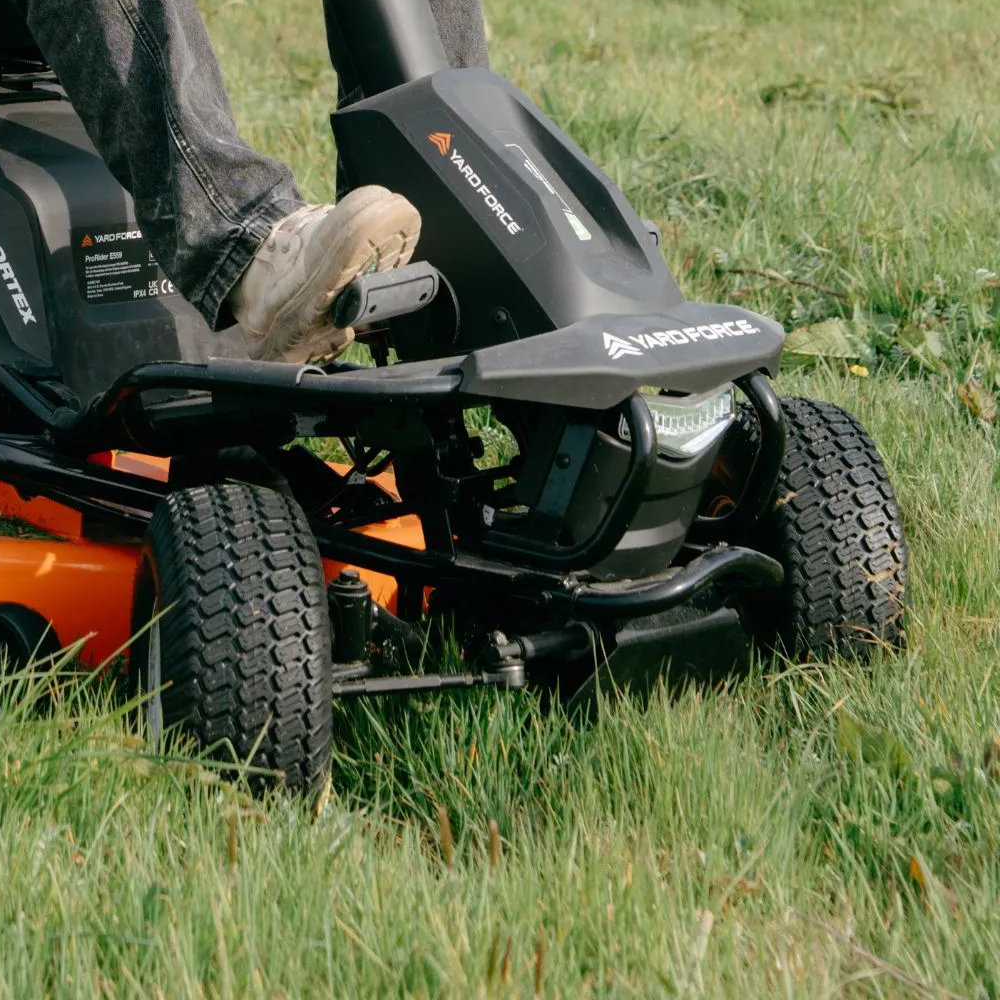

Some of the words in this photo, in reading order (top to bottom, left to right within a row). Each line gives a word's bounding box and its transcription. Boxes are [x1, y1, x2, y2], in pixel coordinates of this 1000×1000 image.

[450, 149, 482, 189] YARD
[477, 183, 521, 235] FORCE
[95, 234, 115, 243] YARD
[149, 281, 158, 289] UK
[133, 290, 147, 298] IPX4
[629, 330, 690, 349] YARD
[687, 319, 756, 343] FORCE
